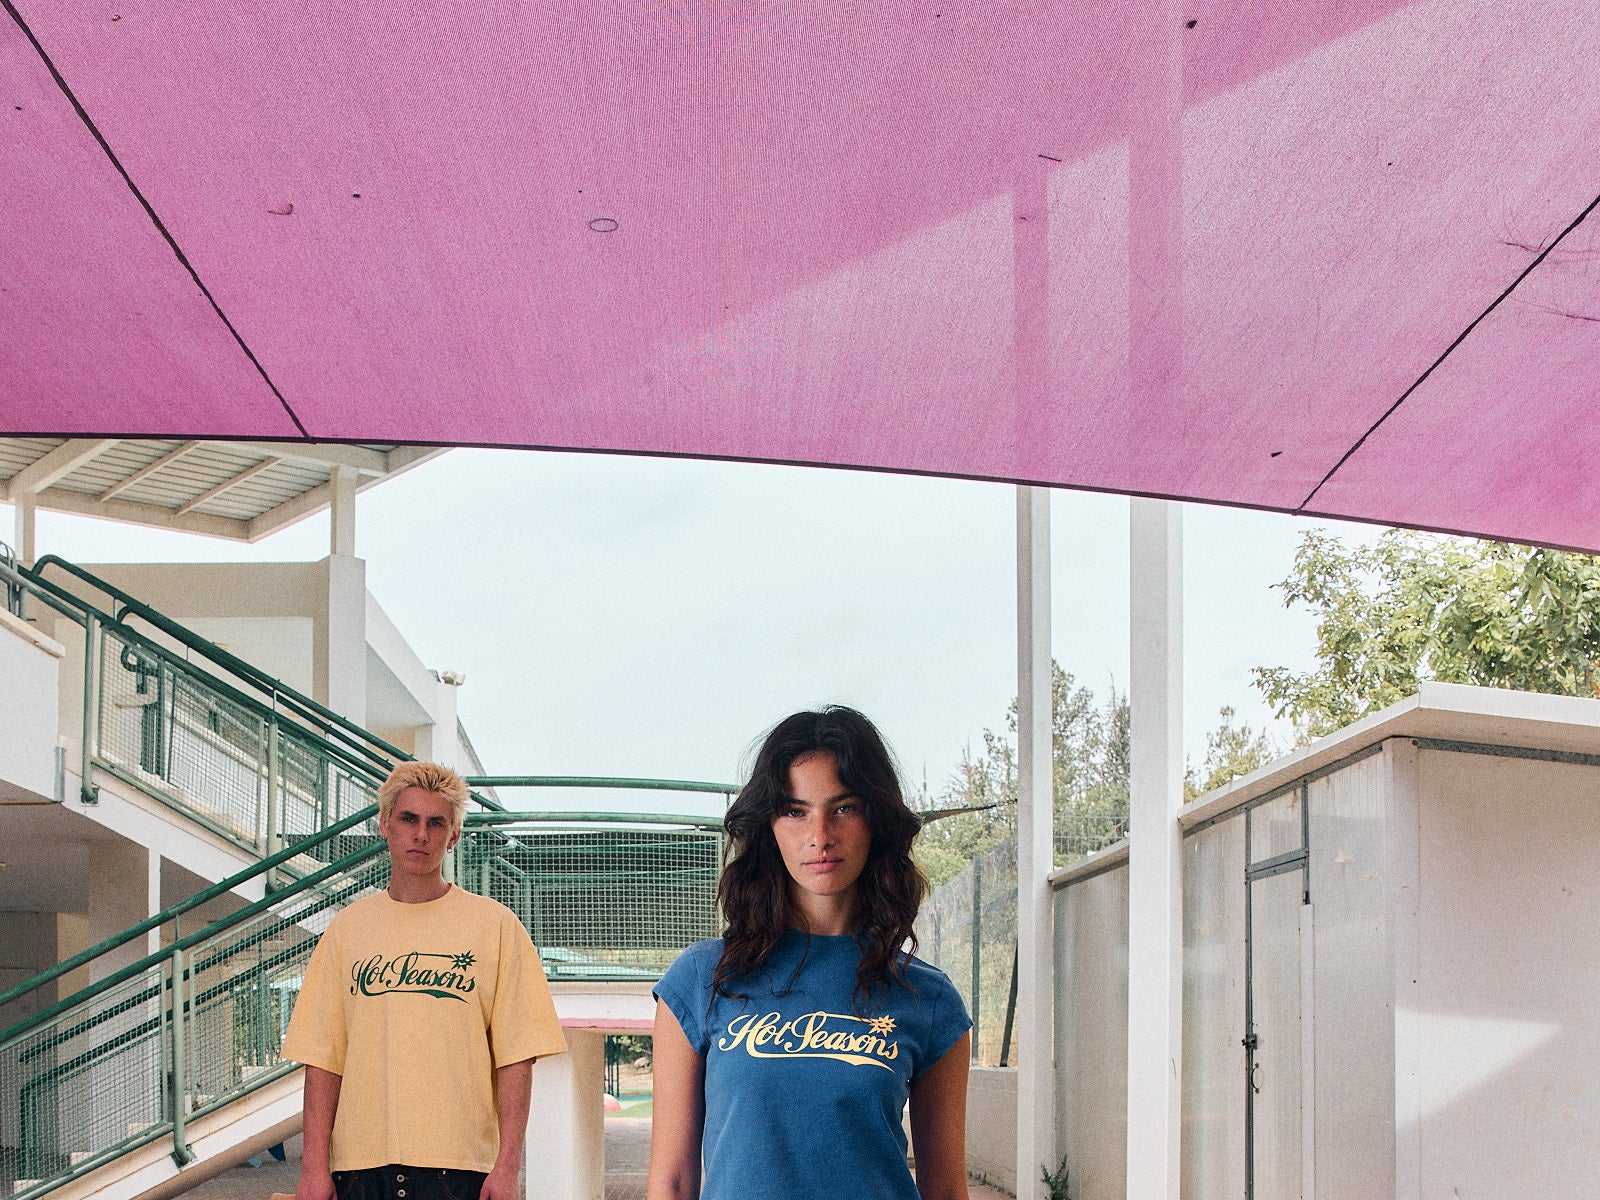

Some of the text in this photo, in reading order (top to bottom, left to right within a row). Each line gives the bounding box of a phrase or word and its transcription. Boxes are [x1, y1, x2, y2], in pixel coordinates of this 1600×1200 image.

[350, 951, 476, 997] Hot Seasons
[718, 1011, 899, 1060] Hot Seasons
